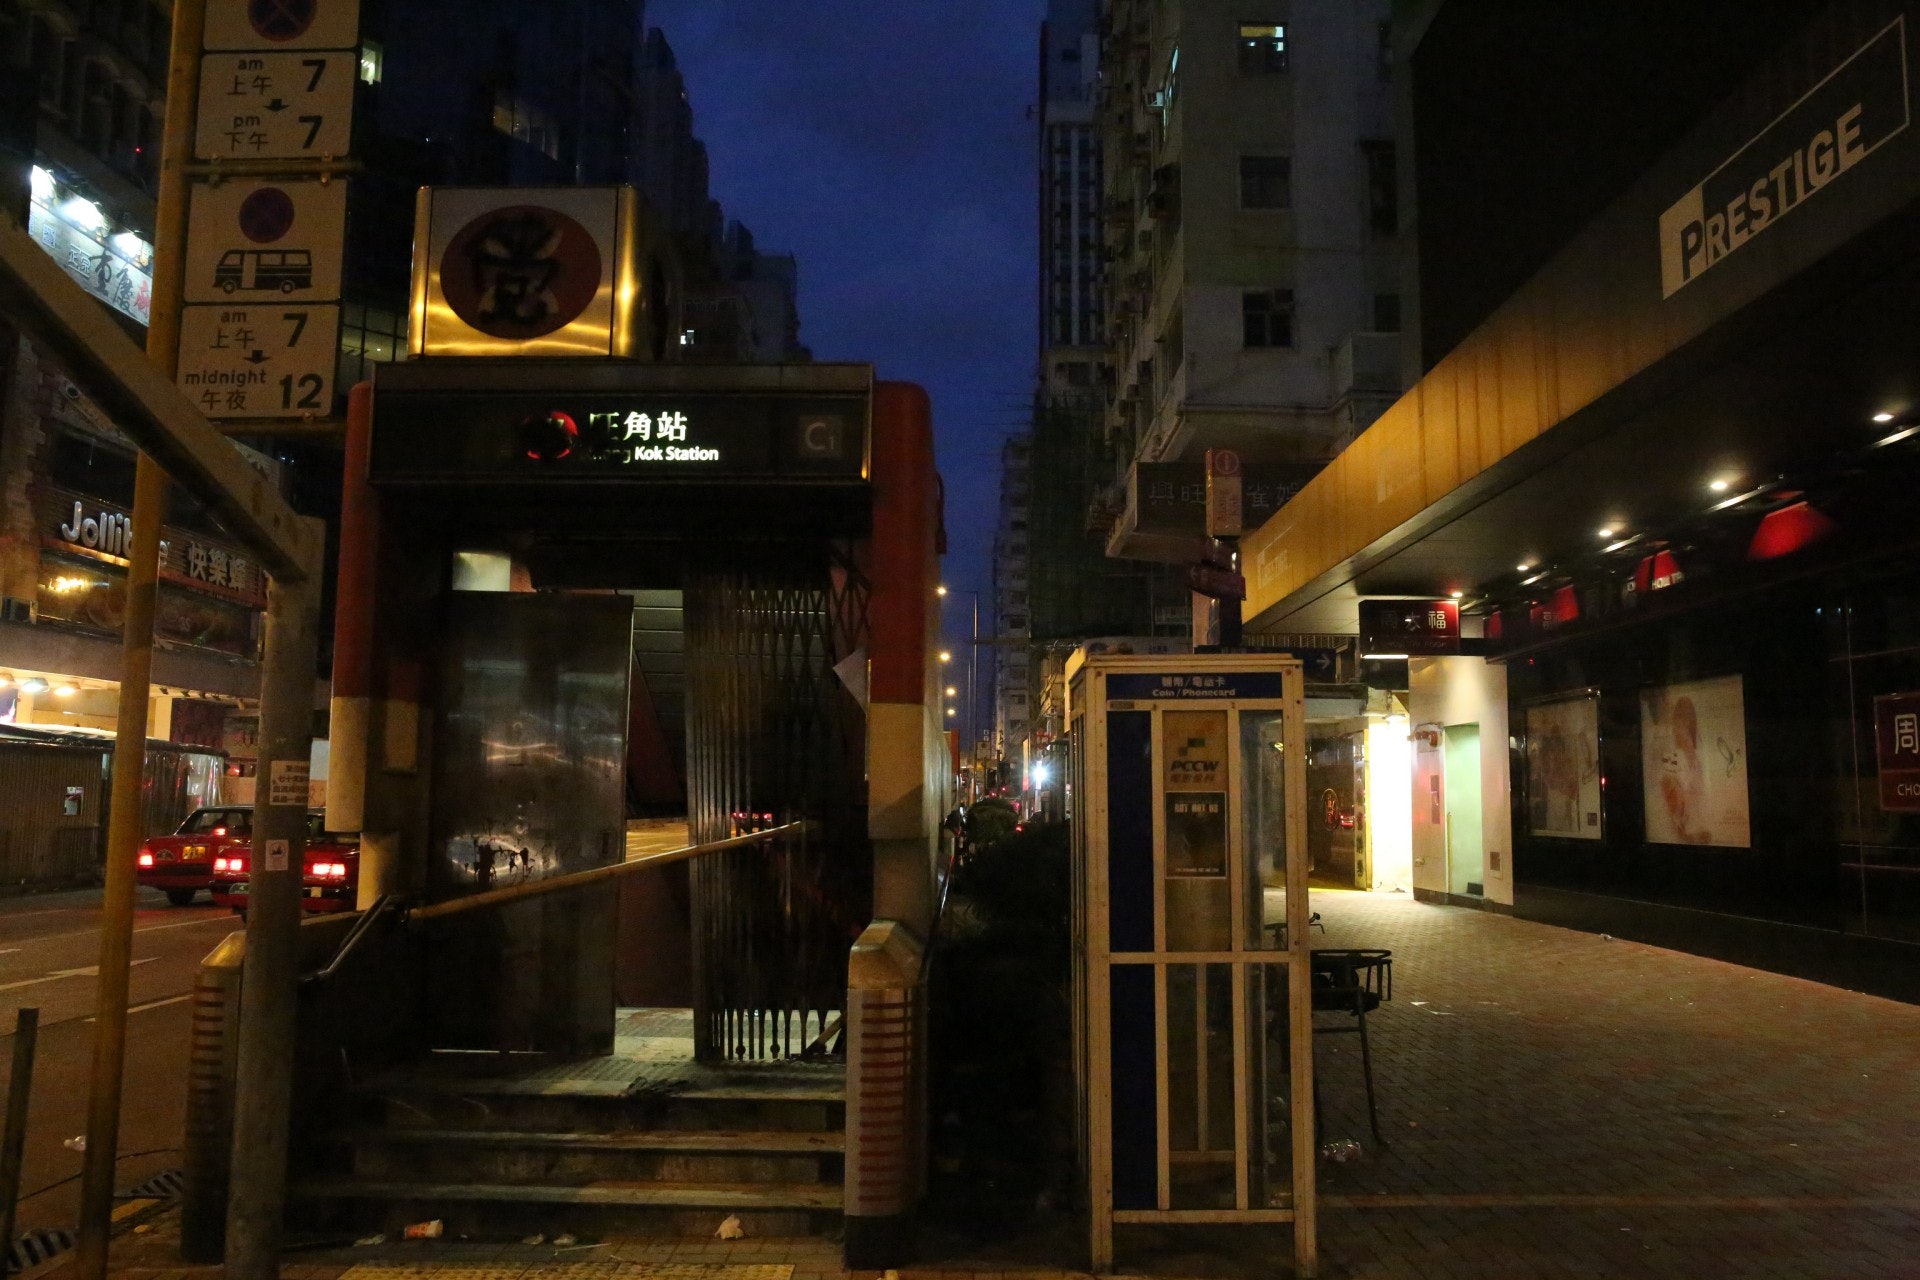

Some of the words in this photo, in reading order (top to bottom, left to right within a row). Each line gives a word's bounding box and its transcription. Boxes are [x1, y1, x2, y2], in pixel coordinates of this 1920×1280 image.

[238, 59, 263, 70] am
[226, 75, 272, 95] 上午
[302, 59, 326, 92] 7
[233, 115, 261, 129] pm
[224, 132, 270, 151] 下午
[298, 115, 323, 150] 7
[1681, 102, 1865, 282] PRESTIGE
[220, 311, 247, 323] am
[210, 328, 255, 349] 上午
[283, 313, 308, 347] 7
[185, 369, 267, 387] midnight
[201, 389, 247, 411] 午夜
[279, 373, 324, 409] 12
[804, 421, 835, 450] C1
[634, 446, 663, 461] Kok
[665, 446, 719, 461] Station
[1152, 688, 1175, 697] Coin
[1182, 688, 1236, 697] Phonecard
[1894, 713, 1920, 755] 周
[1171, 760, 1219, 771] PCCW
